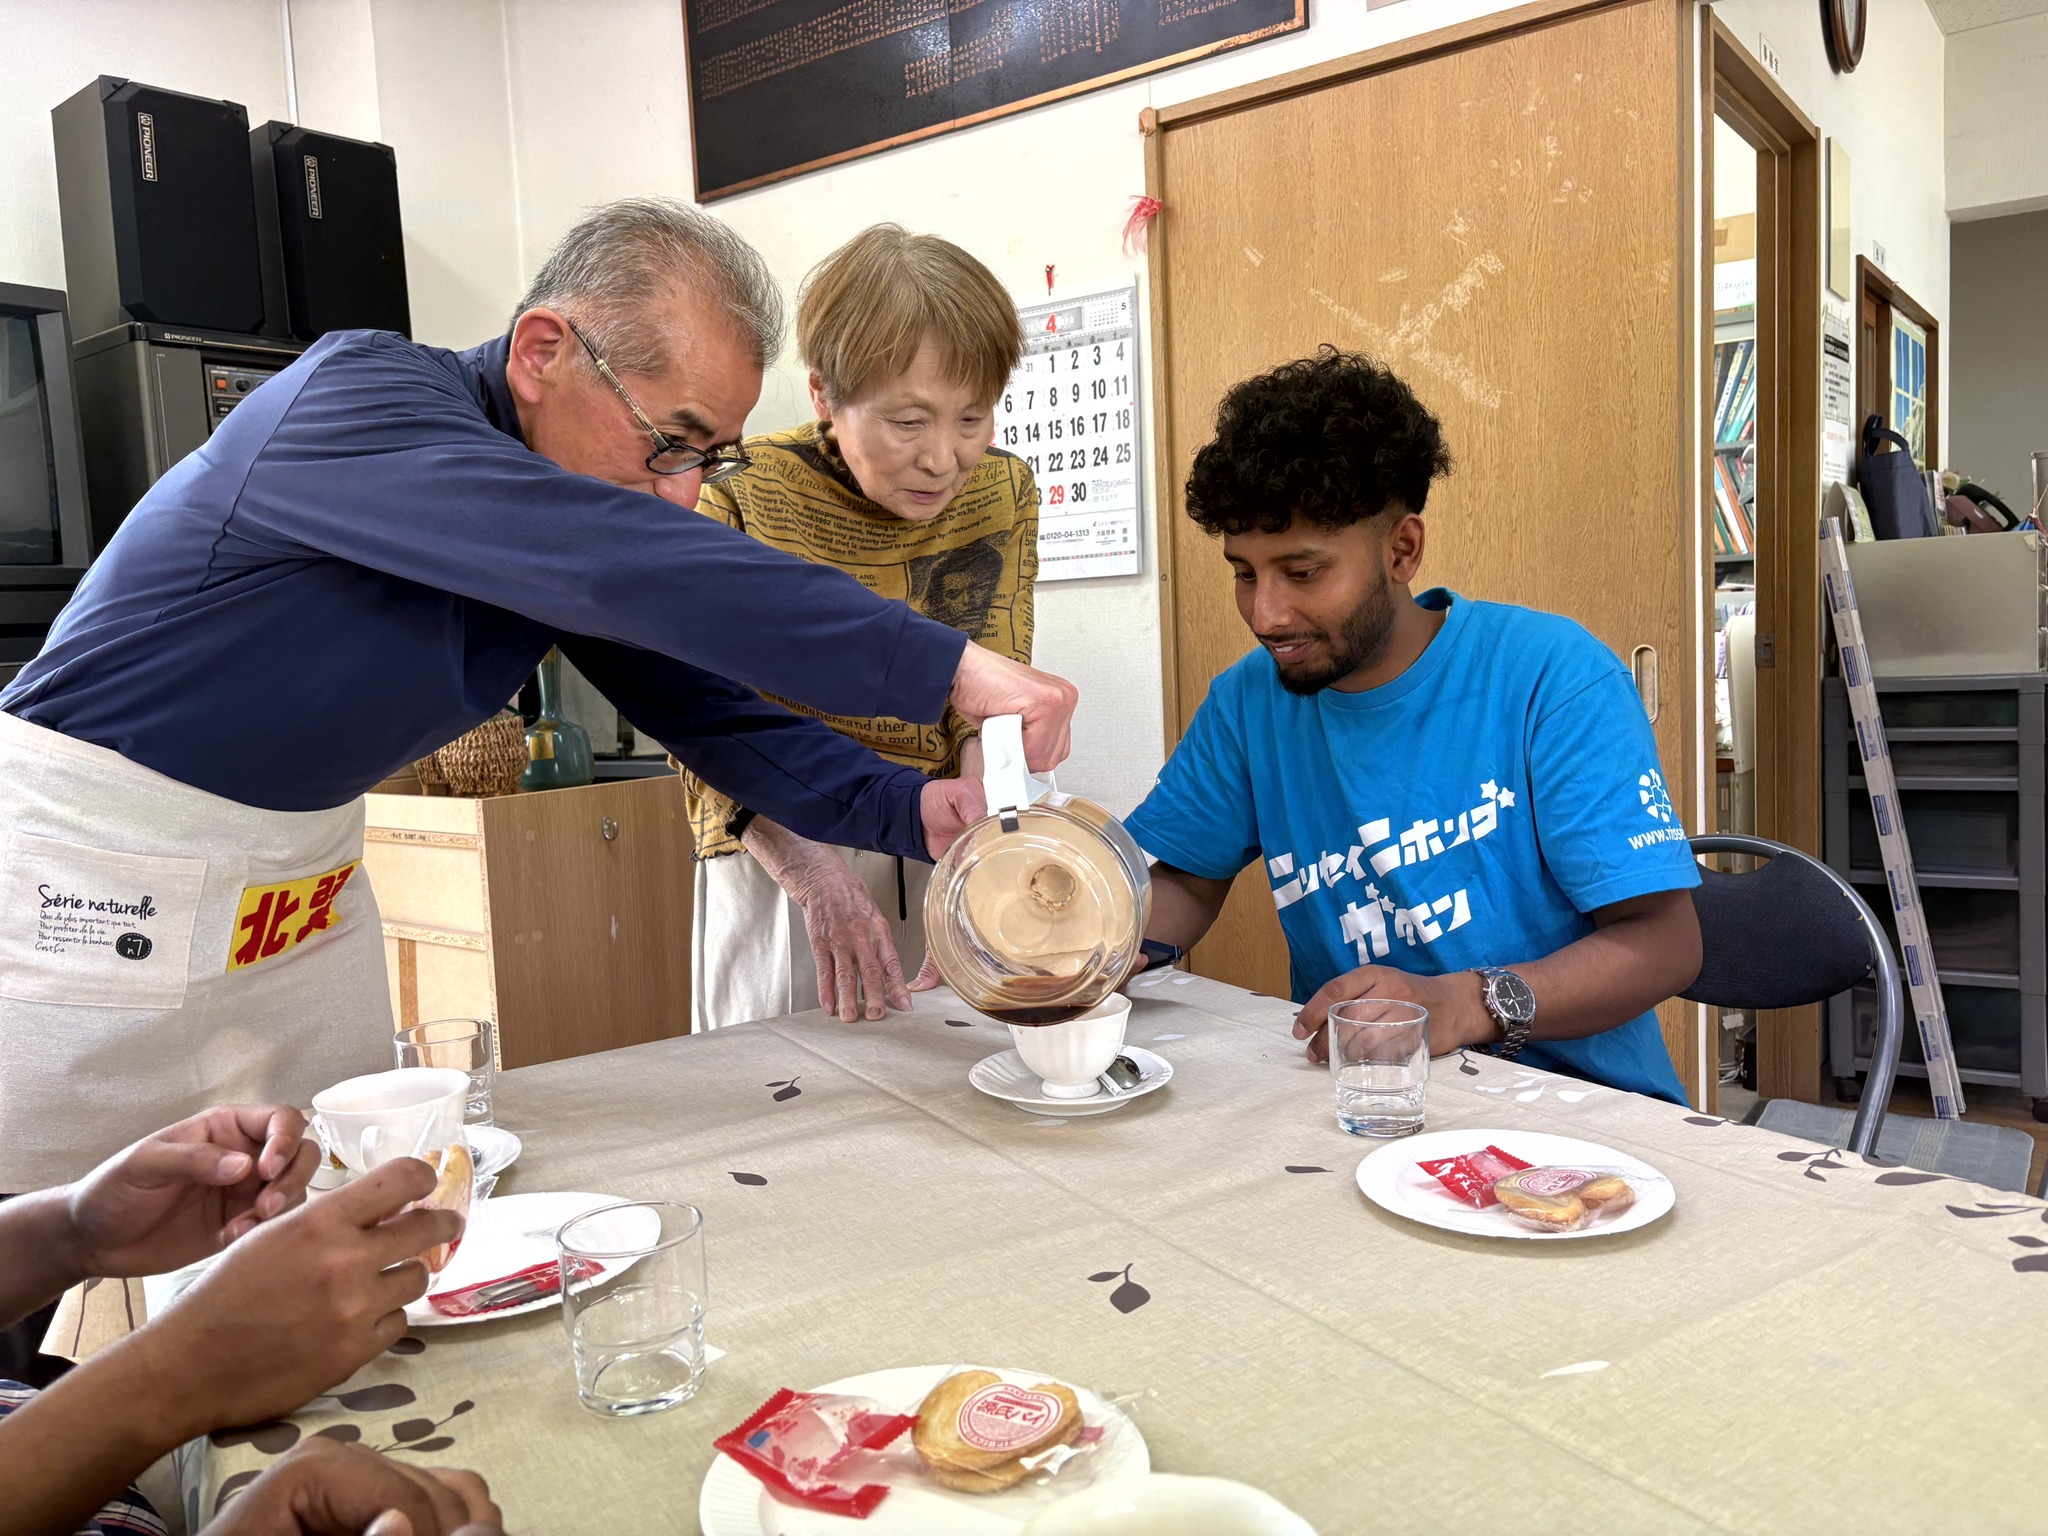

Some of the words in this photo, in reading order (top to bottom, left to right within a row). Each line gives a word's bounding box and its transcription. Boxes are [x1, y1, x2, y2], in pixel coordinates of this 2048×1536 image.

[142, 127, 154, 178] PIONEER
[308, 168, 319, 216] PIONEER
[1121, 302, 1127, 310] 5
[1045, 314, 1057, 333] 4
[171, 333, 202, 342] PIONEER
[1026, 362, 1034, 372] 31
[1049, 354, 1055, 373] 1
[1071, 350, 1079, 370] 2
[1094, 345, 1101, 365] 3
[1116, 341, 1124, 361] 4
[1005, 394, 1012, 413] 6
[1027, 390, 1034, 410] 7
[1050, 387, 1058, 406] 8
[1072, 383, 1080, 403] 9
[1091, 378, 1106, 399] 10
[1114, 374, 1128, 396] 11
[1003, 425, 1018, 446] 13
[1025, 422, 1040, 442] 14
[1048, 420, 1062, 440] 15
[1070, 415, 1085, 437] 16
[1092, 412, 1107, 433] 17
[1115, 408, 1130, 430] 18
[1027, 455, 1040, 474] 21
[1048, 452, 1064, 473] 22
[1070, 449, 1086, 470] 23
[1093, 446, 1109, 467] 24
[1116, 442, 1131, 464] 25
[1049, 484, 1065, 505] 29
[1071, 481, 1087, 502] 30
[803, 503, 848, 523] development
[814, 531, 834, 544] brand
[835, 538, 850, 549] that
[815, 524, 846, 540] Company
[1046, 529, 1090, 540] 0120-04-1313
[876, 720, 908, 733] ther
[888, 735, 917, 745] mor
[38, 884, 85, 909] Série
[88, 895, 158, 921] naturelle
[40, 920, 53, 930] Pour
[53, 923, 79, 935] profiter
[79, 925, 88, 934] de
[54, 912, 63, 921] de
[63, 913, 78, 924] plus
[79, 918, 110, 927] important
[110, 921, 121, 930] que
[38, 931, 51, 941] Pour
[52, 936, 81, 944] ressentir
[81, 936, 89, 946] le
[975, 1399, 1046, 1425] 源氏パイ
